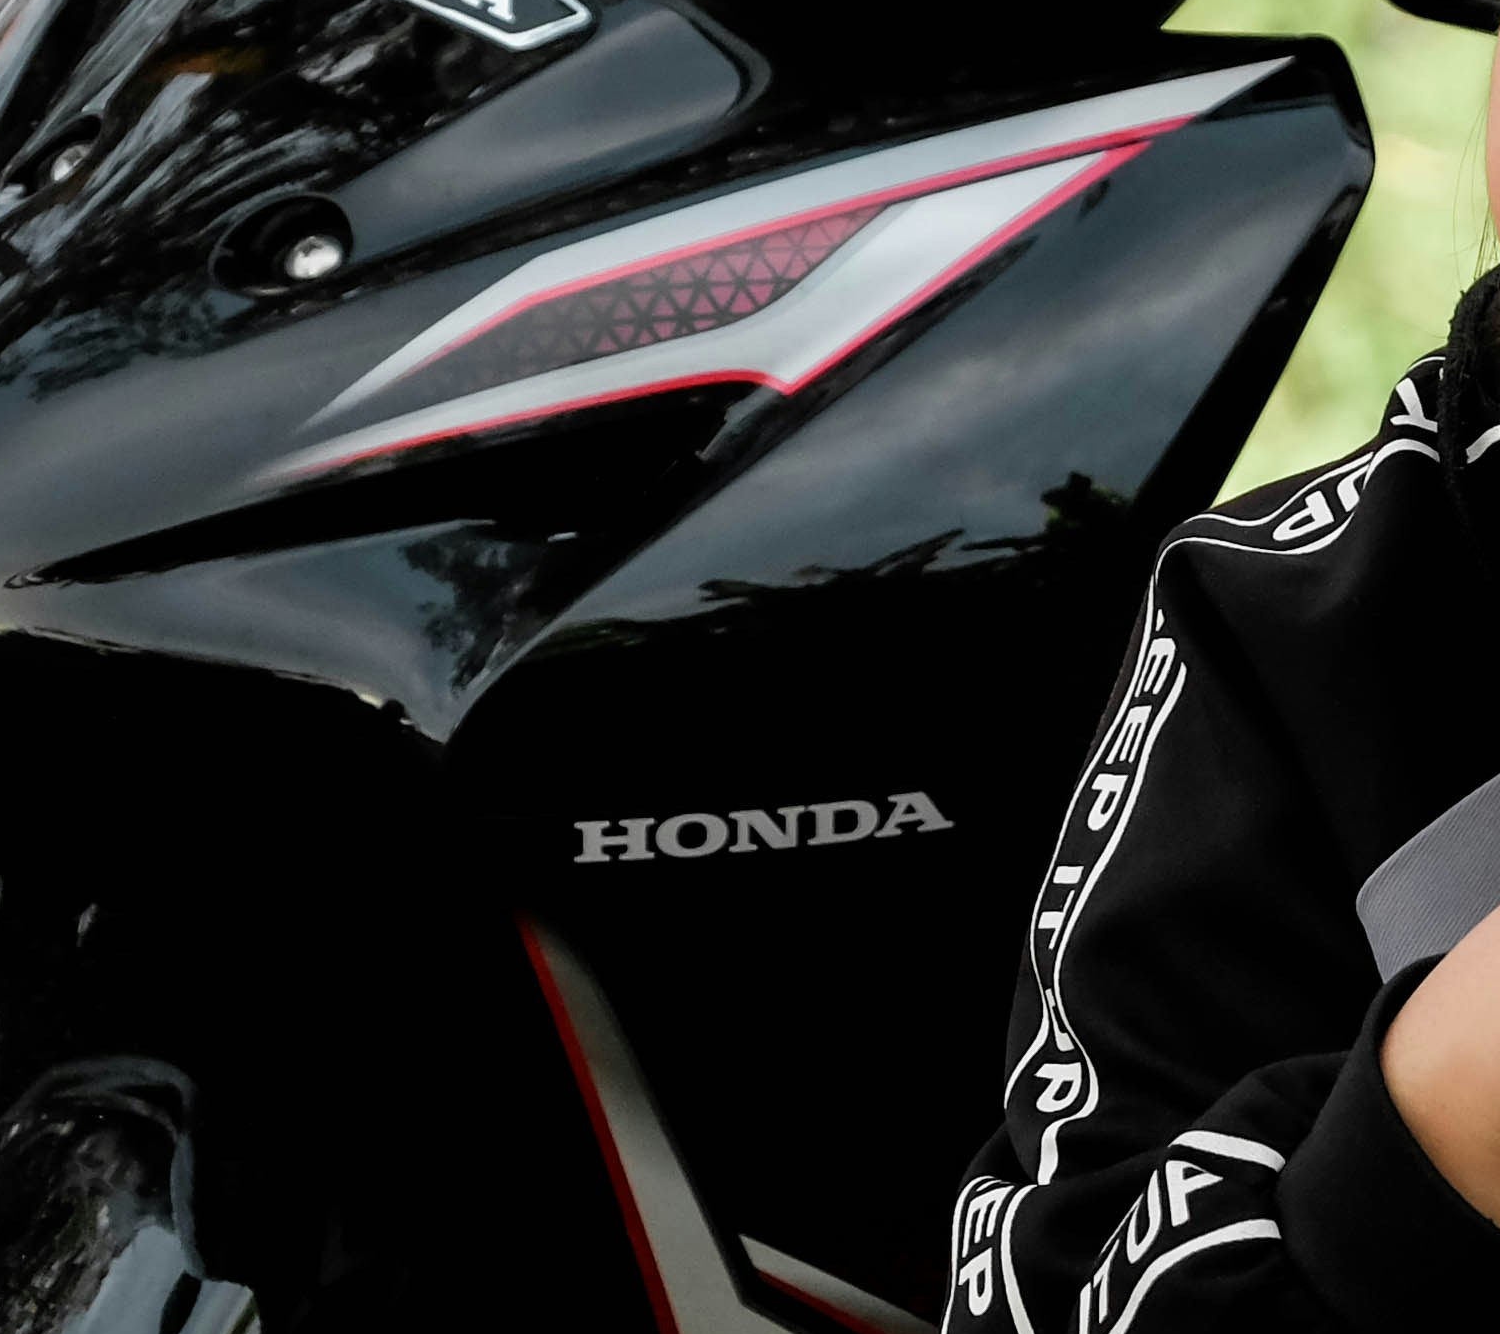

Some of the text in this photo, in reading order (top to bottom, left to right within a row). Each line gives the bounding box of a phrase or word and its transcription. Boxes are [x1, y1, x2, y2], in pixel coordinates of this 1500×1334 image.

[1087, 608, 1177, 832] EEP
[573, 791, 956, 864] HONDA
[1037, 865, 1085, 951] IT
[957, 1179, 1016, 1317] EP
